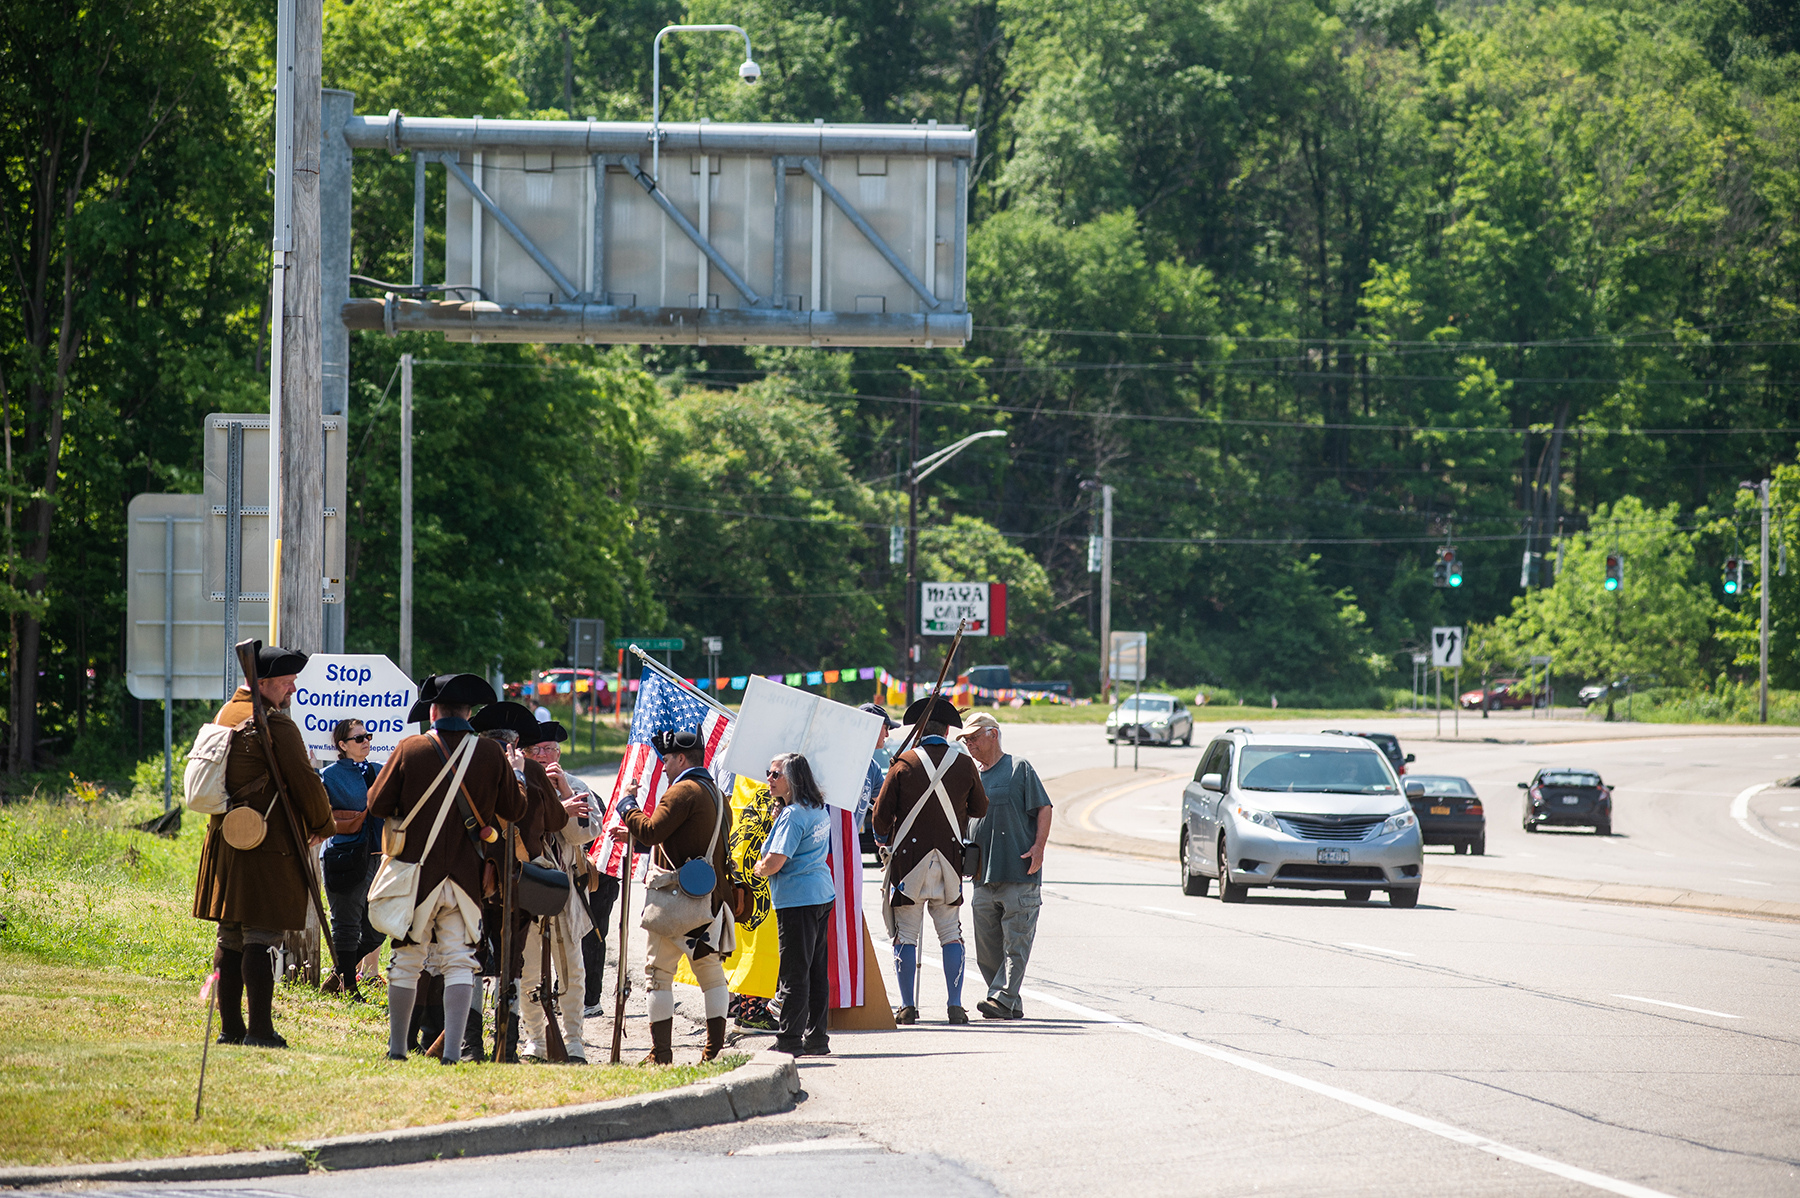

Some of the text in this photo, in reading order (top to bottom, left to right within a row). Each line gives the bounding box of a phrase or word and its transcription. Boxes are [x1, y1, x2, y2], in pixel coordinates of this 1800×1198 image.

[934, 602, 977, 619] CAFÉ
[326, 664, 371, 686] Stop
[296, 688, 410, 707] Continental
